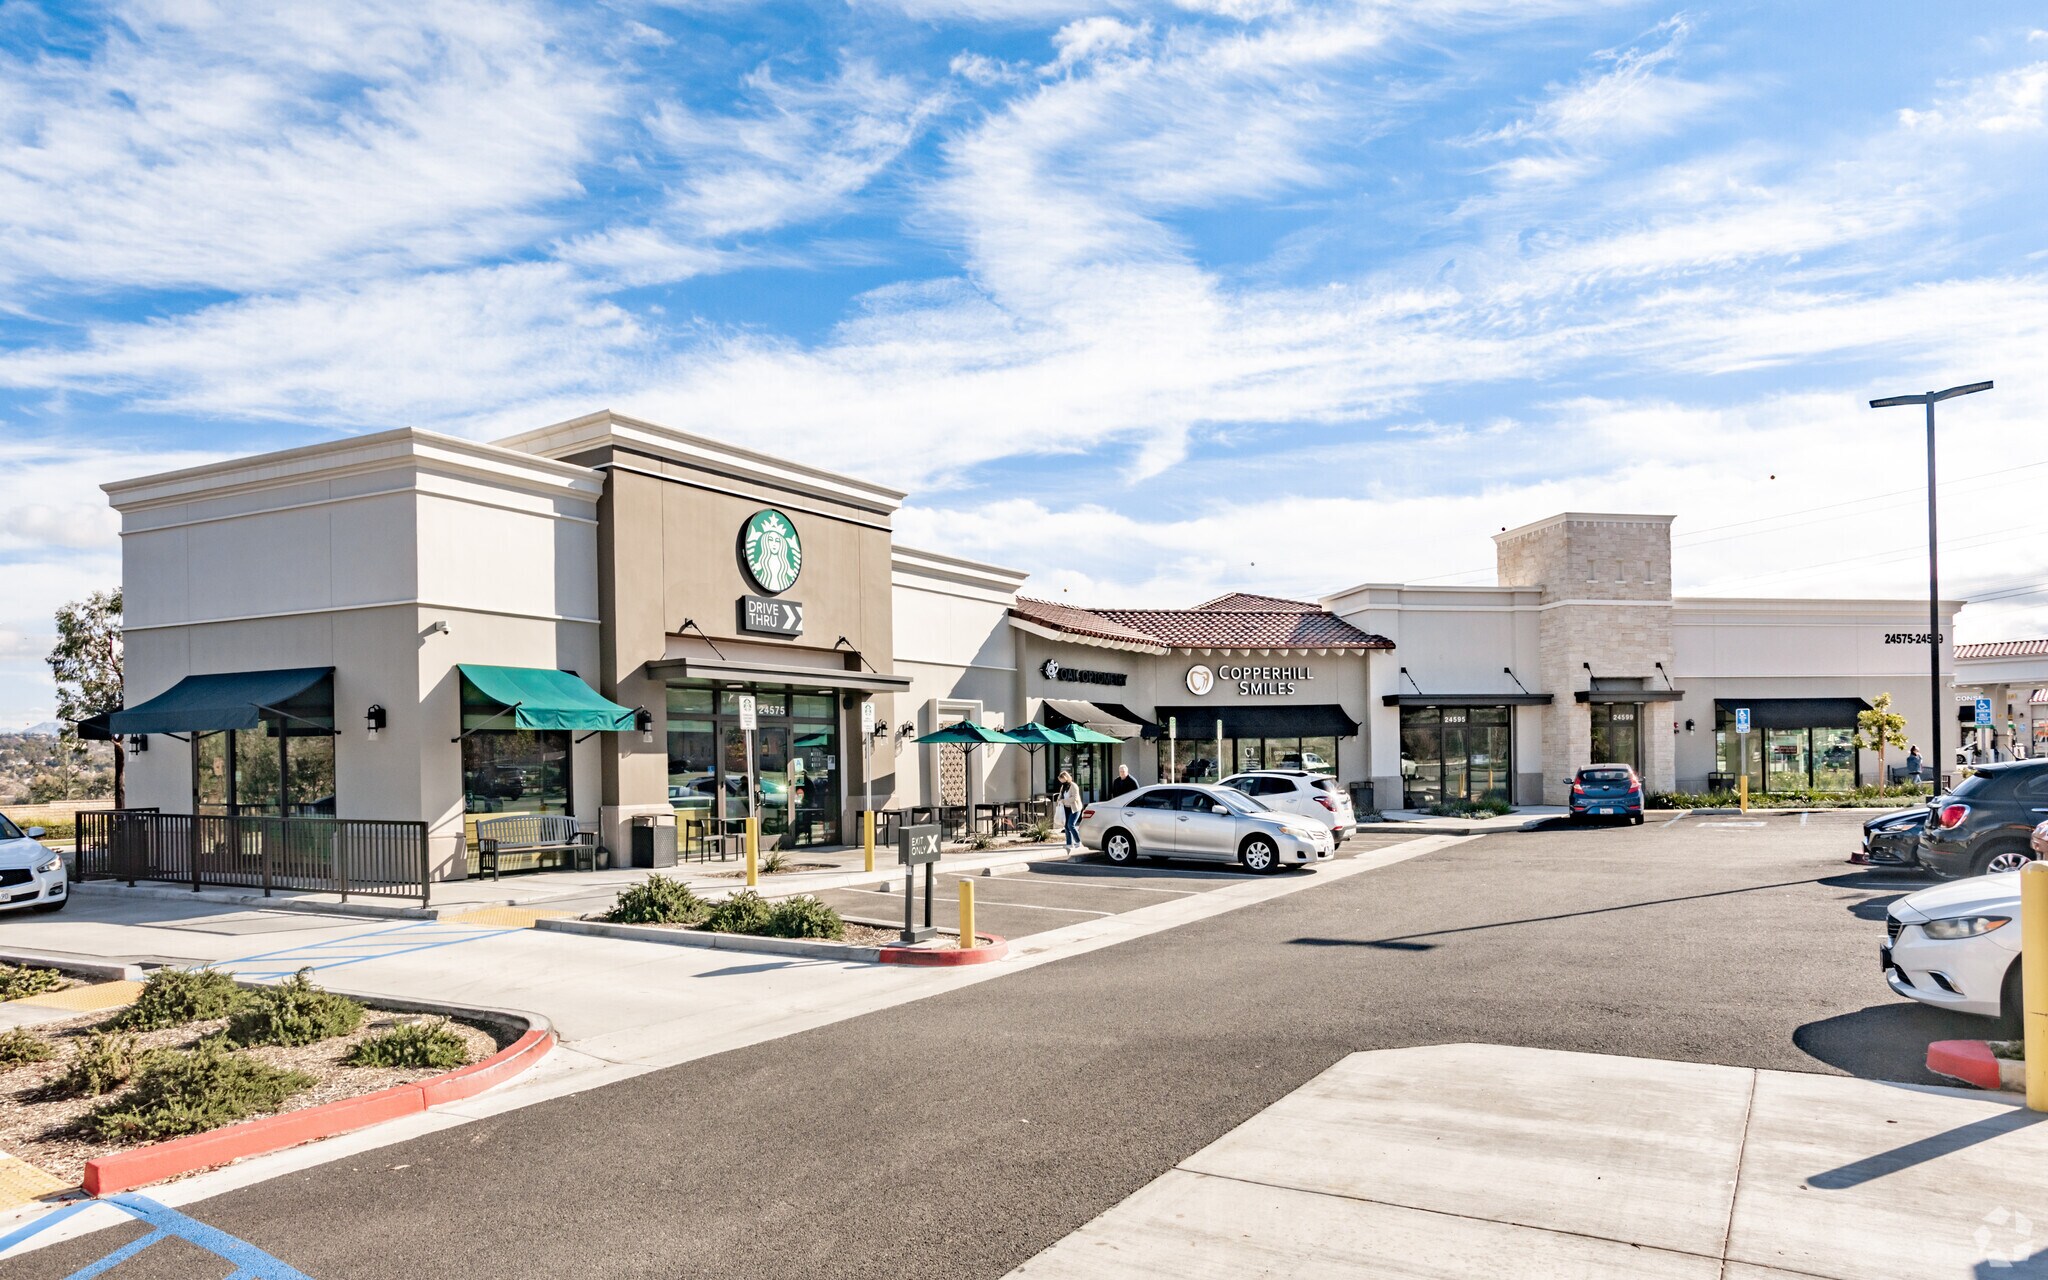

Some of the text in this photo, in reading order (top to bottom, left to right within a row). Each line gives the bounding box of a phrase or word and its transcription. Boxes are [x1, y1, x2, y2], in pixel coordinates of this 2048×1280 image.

[748, 600, 779, 616] DRIVE
[748, 612, 777, 628] THRU
[1884, 633, 1944, 644] 24575-2459
[1218, 664, 1314, 681] COPPERHILL
[1239, 680, 1296, 696] SMILES
[758, 705, 786, 715] 24575
[911, 836, 924, 847] EXIT
[911, 845, 927, 856] ONLY
